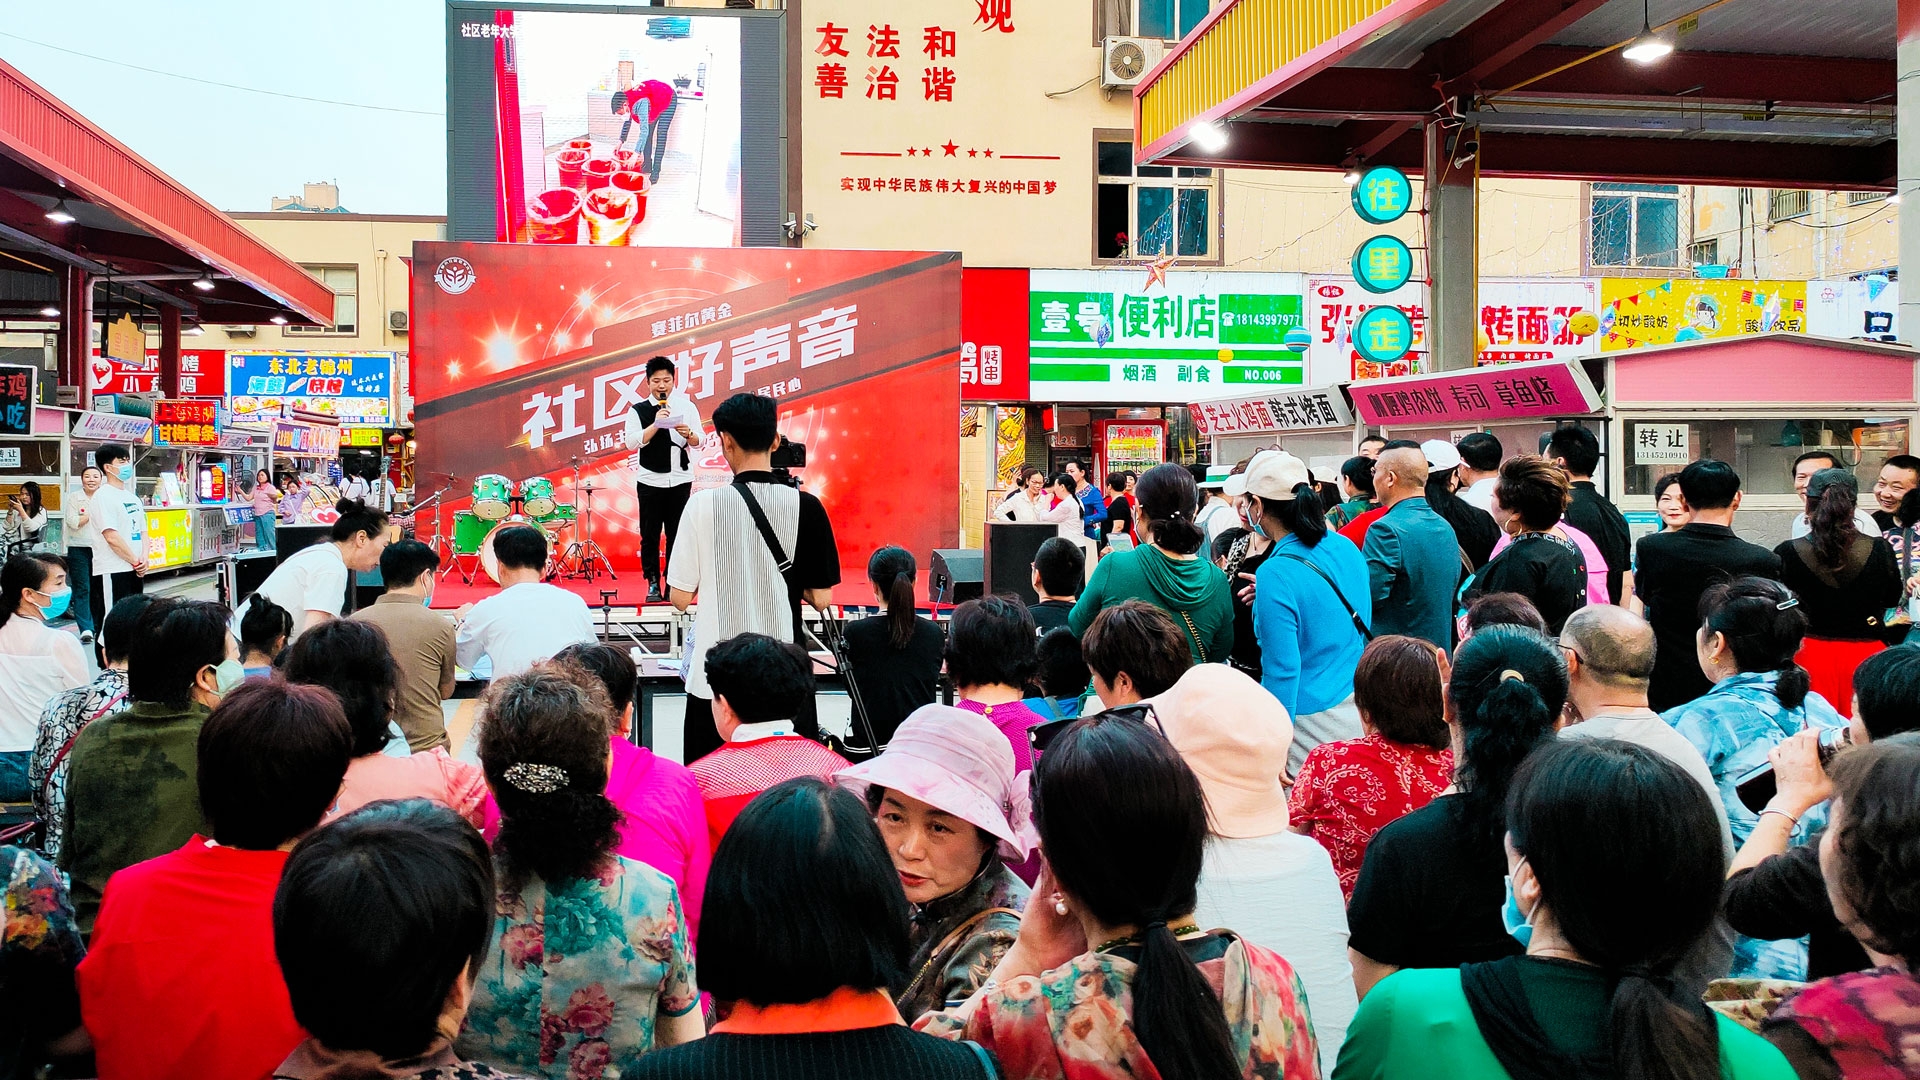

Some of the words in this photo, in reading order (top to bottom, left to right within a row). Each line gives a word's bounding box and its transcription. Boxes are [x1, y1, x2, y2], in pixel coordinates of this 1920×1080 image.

[840, 177, 1058, 196] 实现中华民族伟大复兴的中国梦
[650, 302, 734, 339] 赛菲尔黄金
[1118, 293, 1217, 339] 便利店
[1236, 313, 1300, 326] 18143997977
[1613, 314, 1669, 329] 切炒酸奶
[1744, 318, 1800, 333] 酸饮品
[267, 356, 354, 376] 东北老锦州
[1122, 363, 1157, 382] 烟酒
[1177, 364, 1212, 383] 副食
[1244, 369, 1282, 381] NO.006
[306, 377, 345, 396] 烧烤
[522, 304, 858, 450] 社区好声音
[1448, 383, 1491, 412] 寿司
[1491, 375, 1561, 409] 章鱼烧
[1205, 400, 1275, 432] 芝士火鸡面
[1267, 393, 1339, 428] 韩式烤面
[1638, 427, 1685, 449] 转让
[1635, 451, 1688, 460] 13145210910
